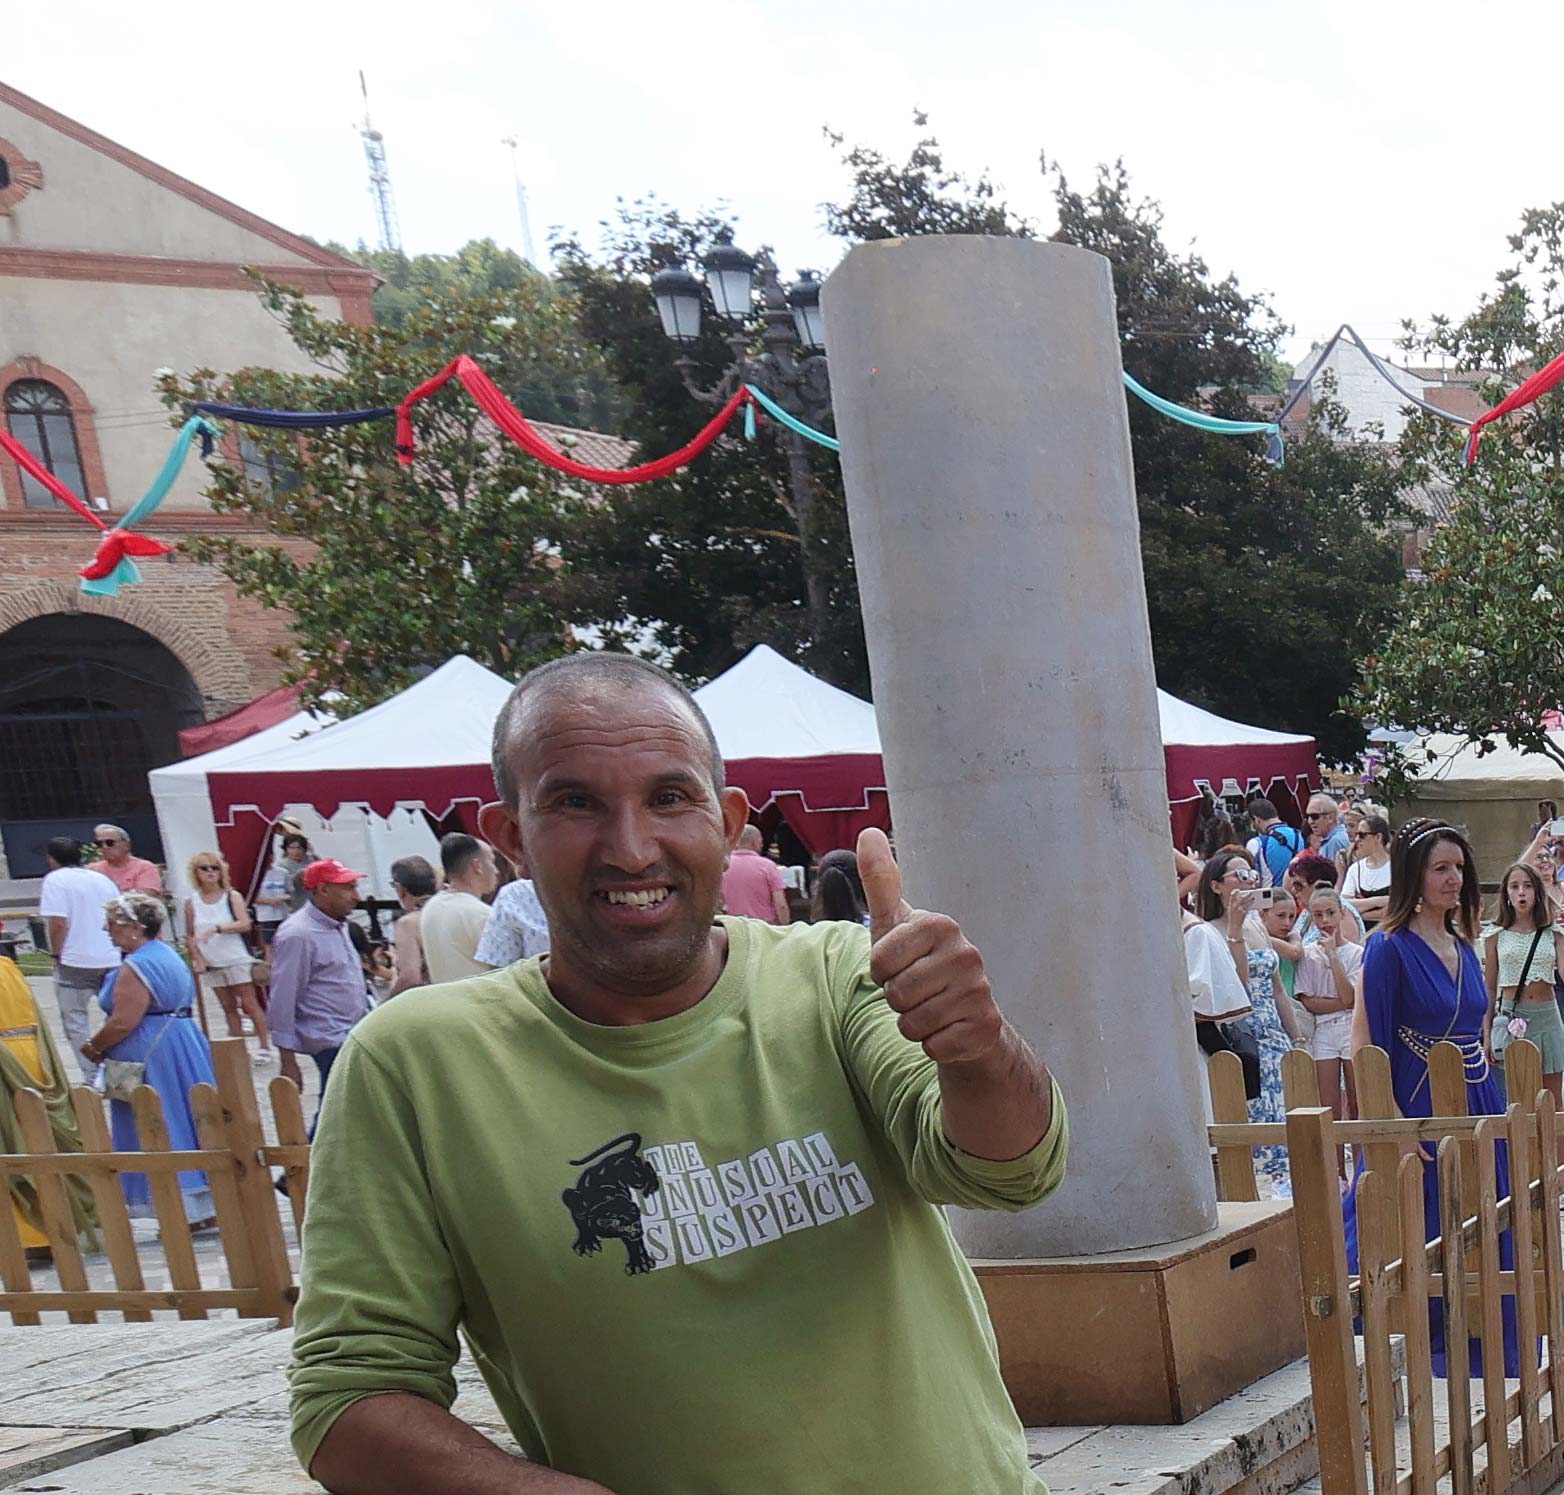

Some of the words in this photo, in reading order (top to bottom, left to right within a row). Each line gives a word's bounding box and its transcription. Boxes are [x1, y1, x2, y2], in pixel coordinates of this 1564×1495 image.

[636, 1141, 834, 1217] UNUSUAL
[646, 1145, 700, 1172] THE
[646, 1171, 865, 1262] SUSPECT
